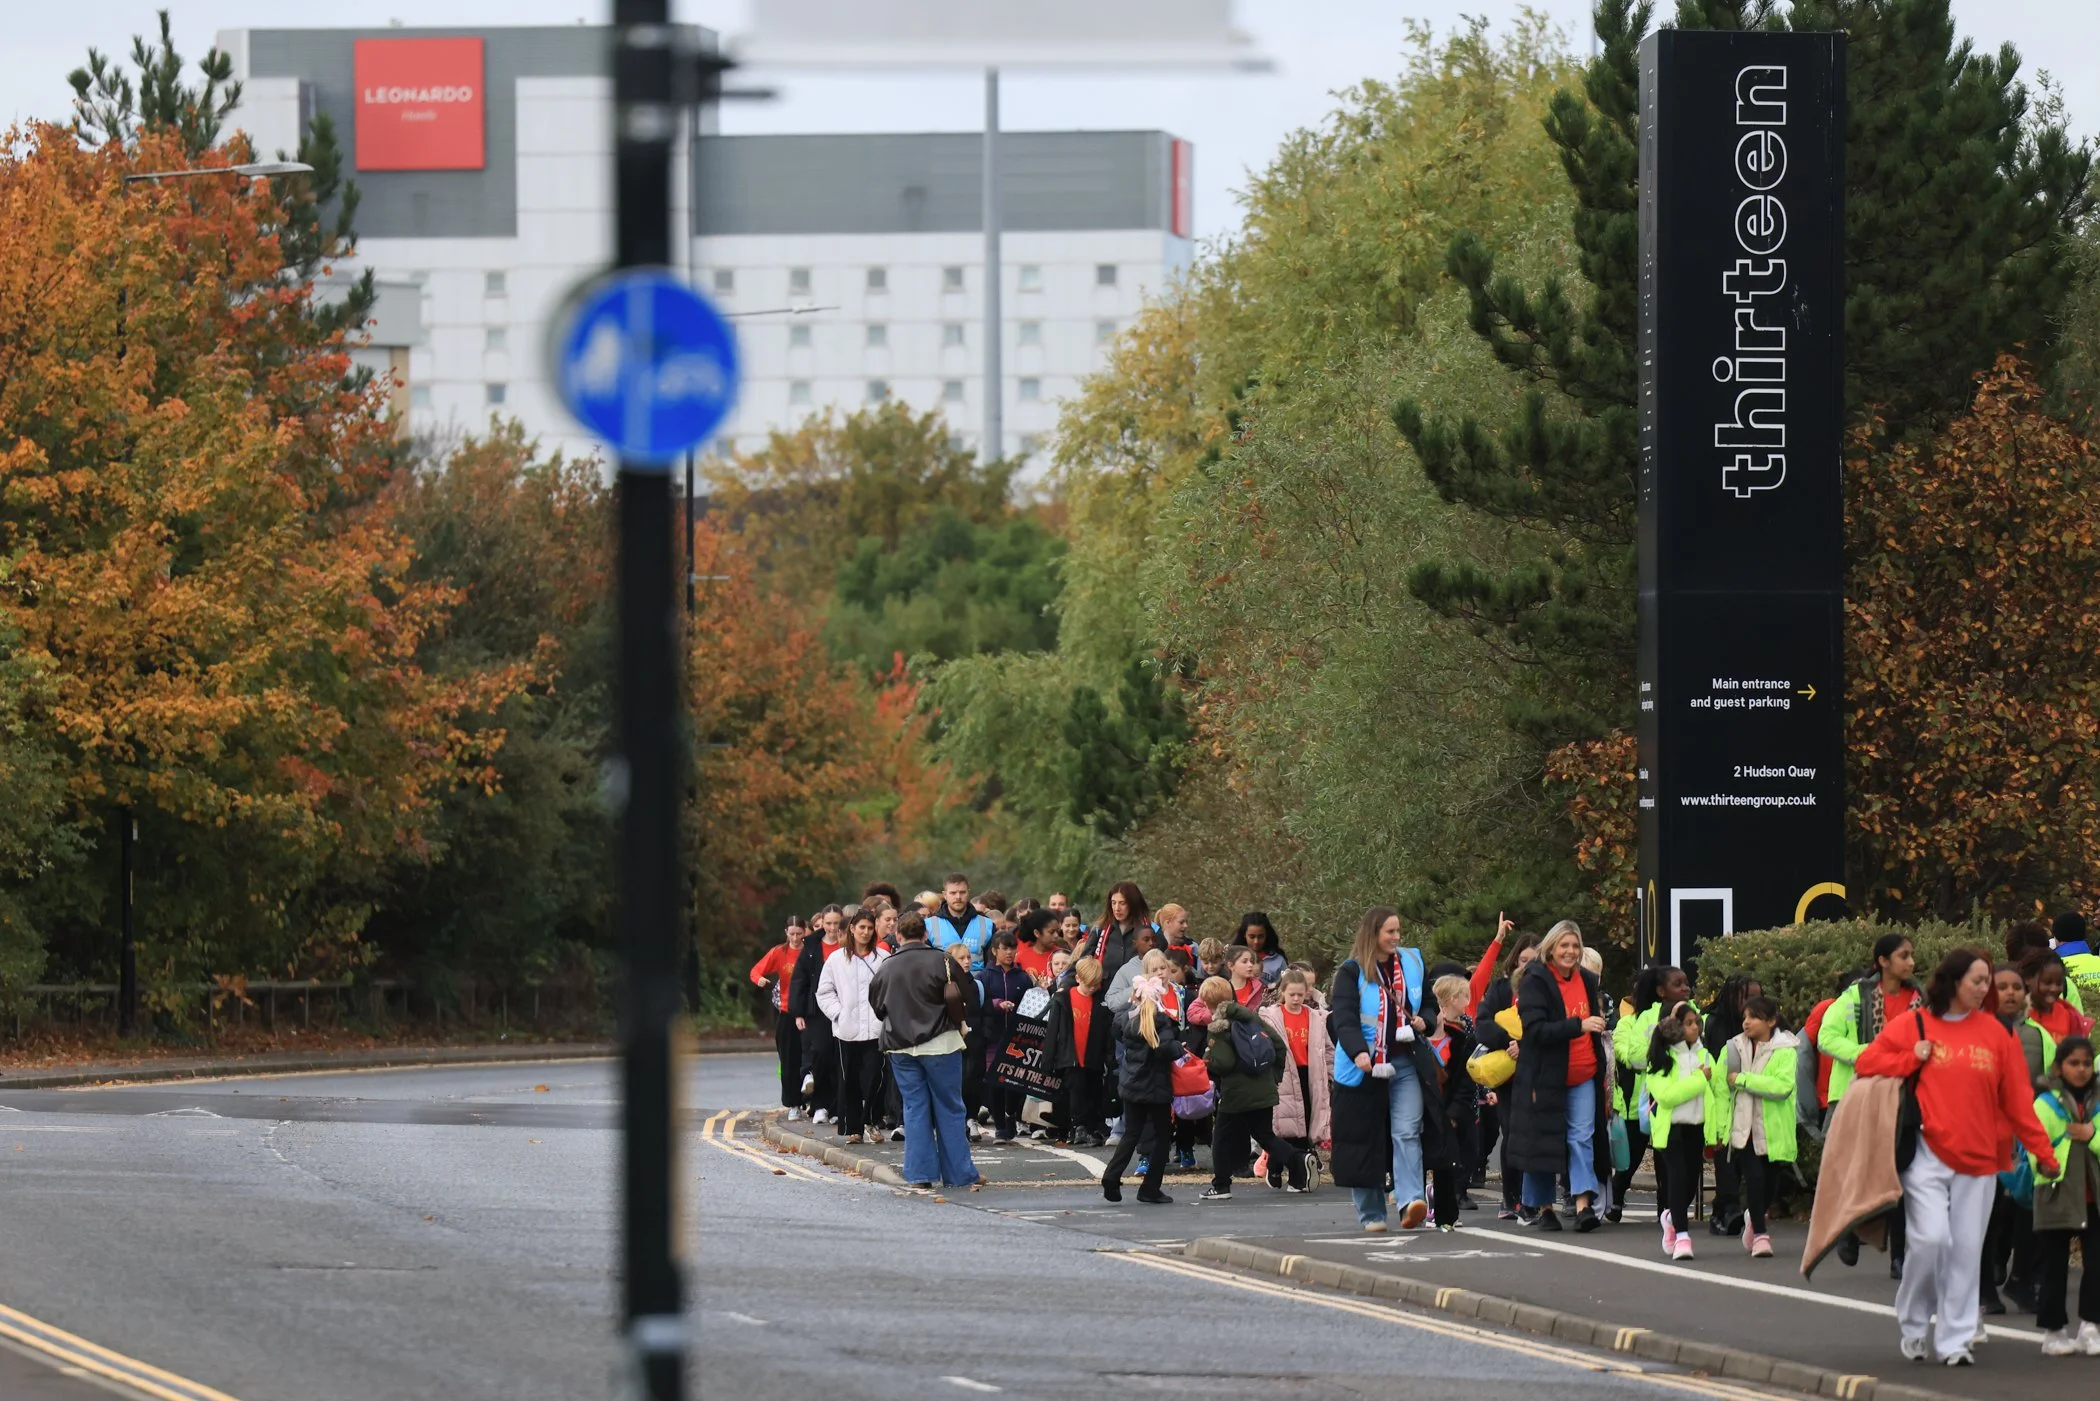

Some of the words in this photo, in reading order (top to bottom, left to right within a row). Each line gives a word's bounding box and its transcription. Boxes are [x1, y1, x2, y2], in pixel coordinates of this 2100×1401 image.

[364, 85, 474, 104] LEONARDO
[1712, 65, 1788, 499] thirteen
[1712, 677, 1739, 690] Main
[1741, 678, 1791, 690] entrance
[1690, 695, 1711, 708] and
[1713, 696, 1746, 710] guest
[1748, 695, 1791, 710] parking
[1733, 765, 1741, 777] 2
[1743, 765, 1786, 777] Hudson
[1787, 765, 1816, 780] Quay
[1680, 793, 1817, 808] www.thirteengroup.co.uk
[996, 1062, 1015, 1076] IT'S
[1014, 1066, 1026, 1079] IN
[1025, 1069, 1043, 1085] THE
[1043, 1075, 1062, 1090] BAG
